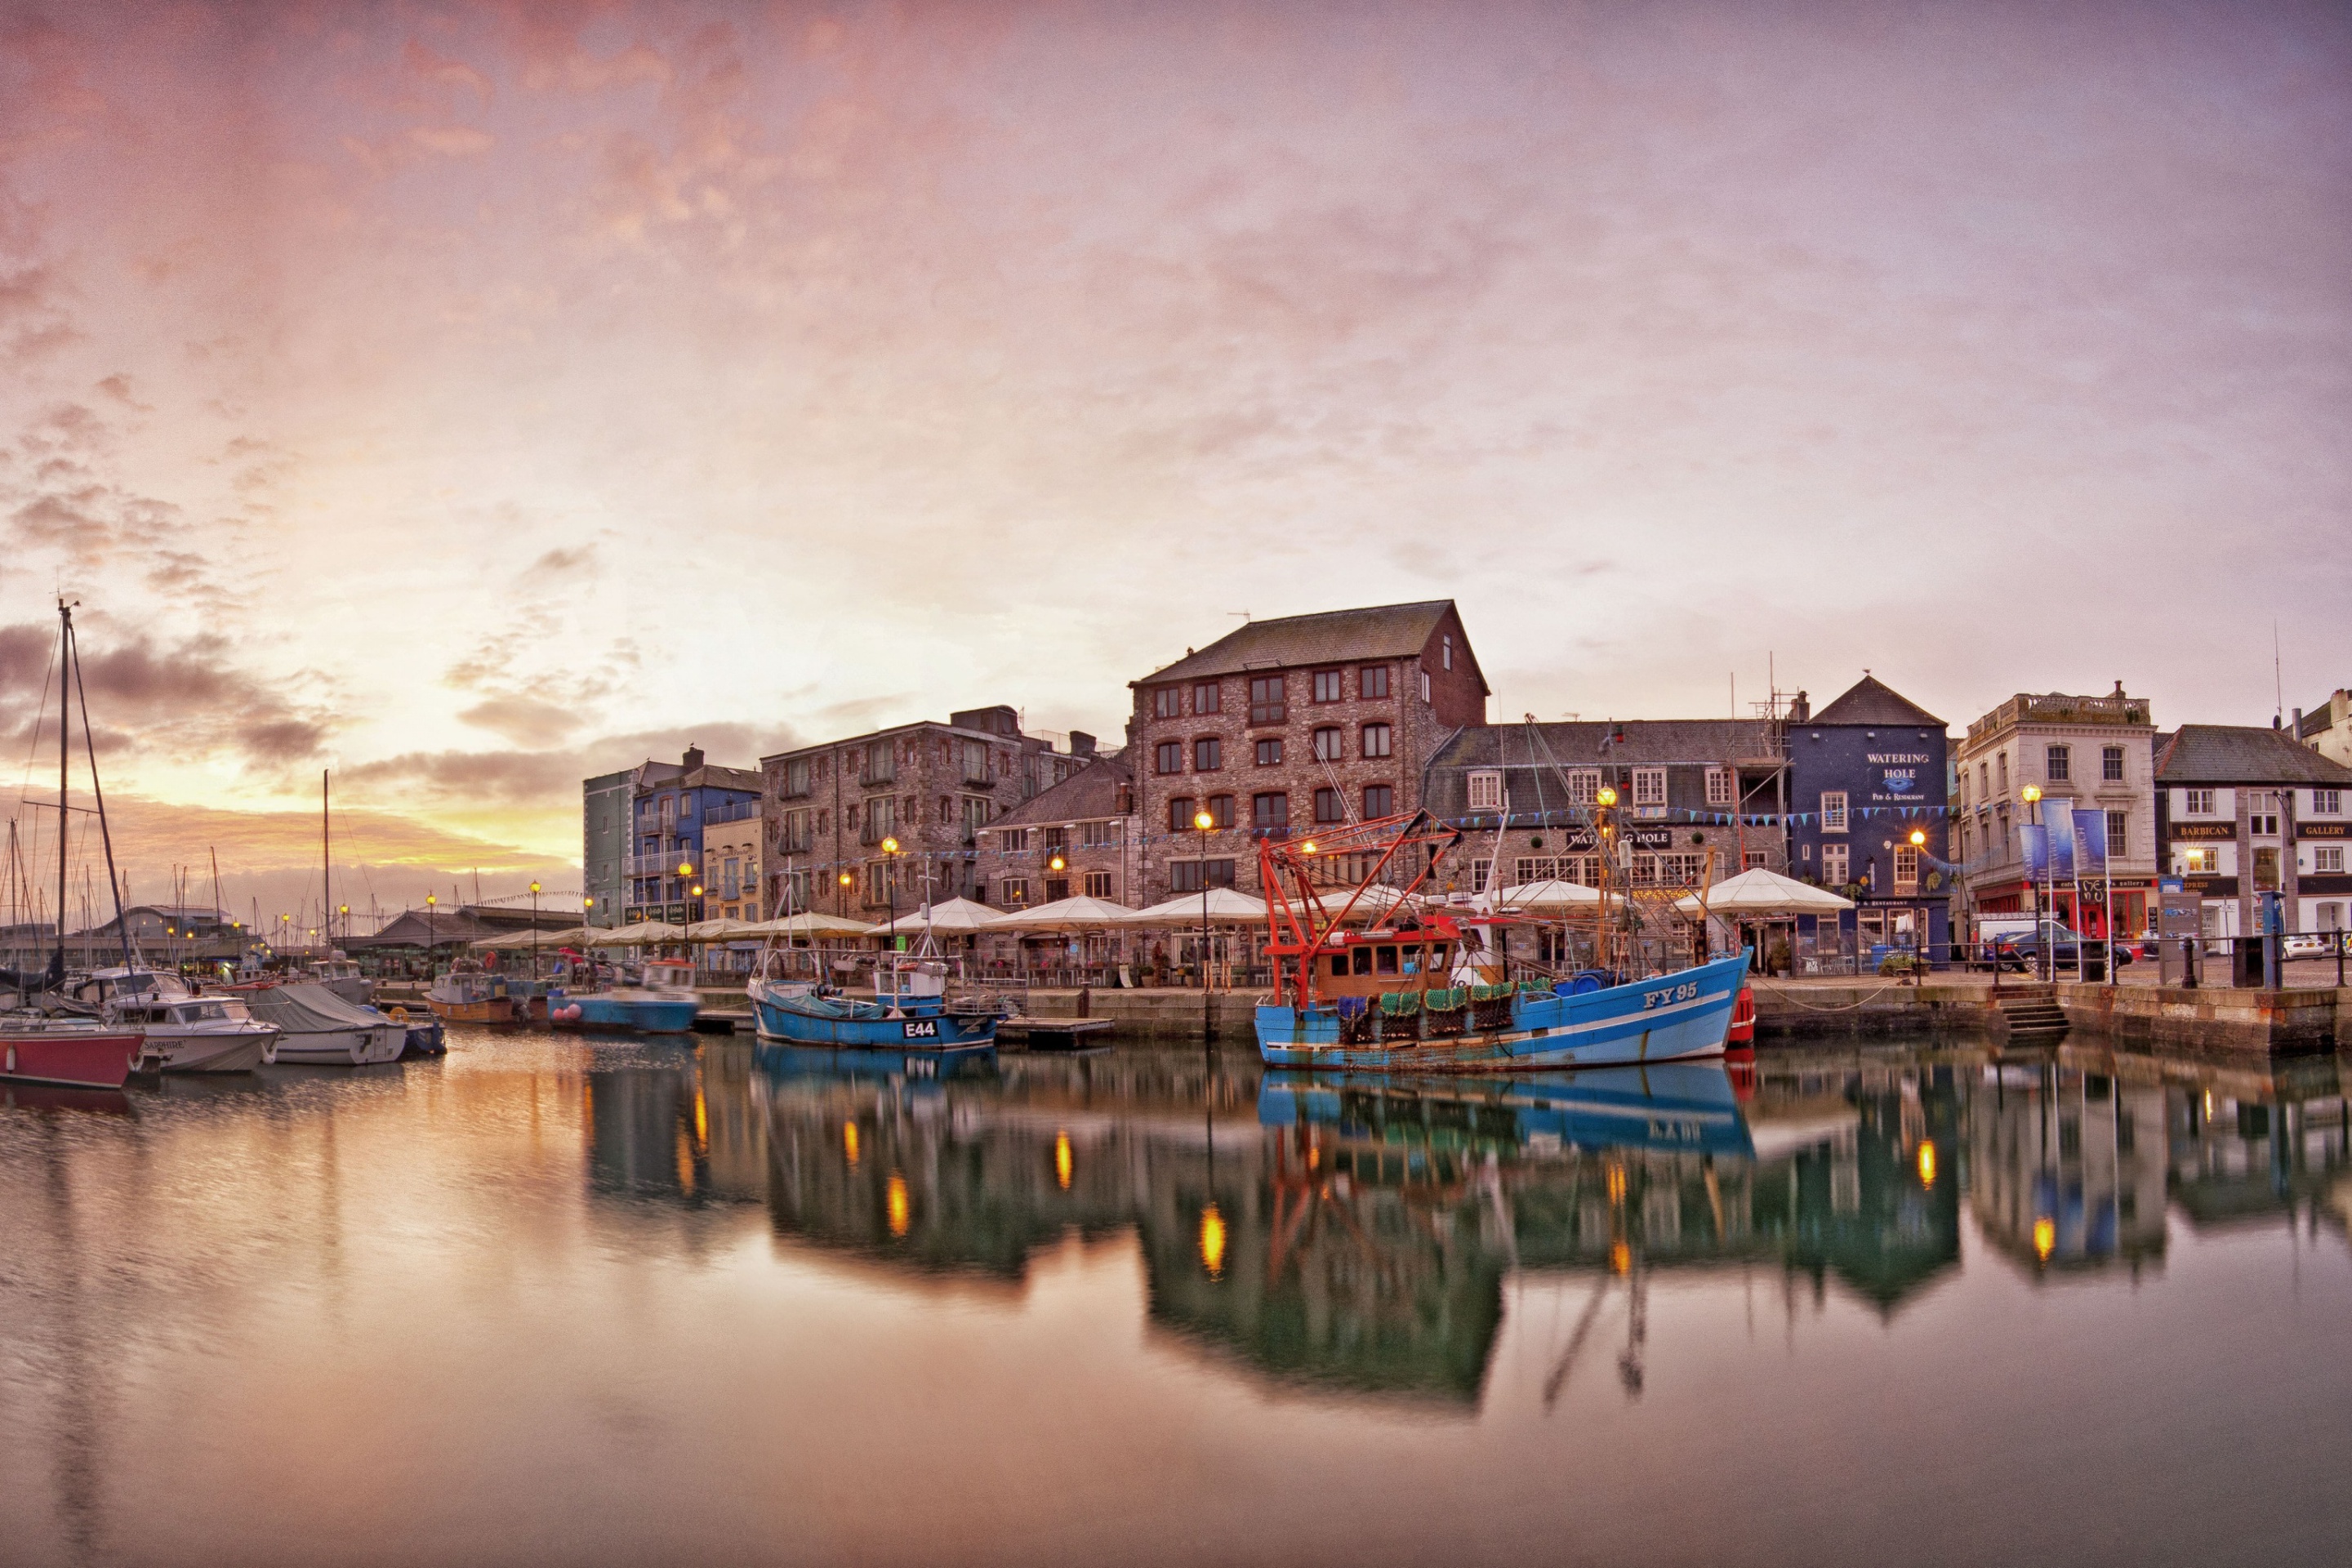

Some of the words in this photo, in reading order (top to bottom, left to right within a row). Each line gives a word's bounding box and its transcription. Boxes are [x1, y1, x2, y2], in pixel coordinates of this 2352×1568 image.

[1867, 754, 1930, 764] WATERING
[1884, 768, 1916, 779] HOLE
[2181, 826, 2228, 835] BARBICAN
[2305, 826, 2345, 835] GALLERY
[2274, 900, 2279, 910] P
[1644, 987, 1675, 1009] FY
[1677, 981, 1697, 1001] 95
[906, 1022, 935, 1038] E44
[145, 1040, 185, 1049] SAPPHIRE
